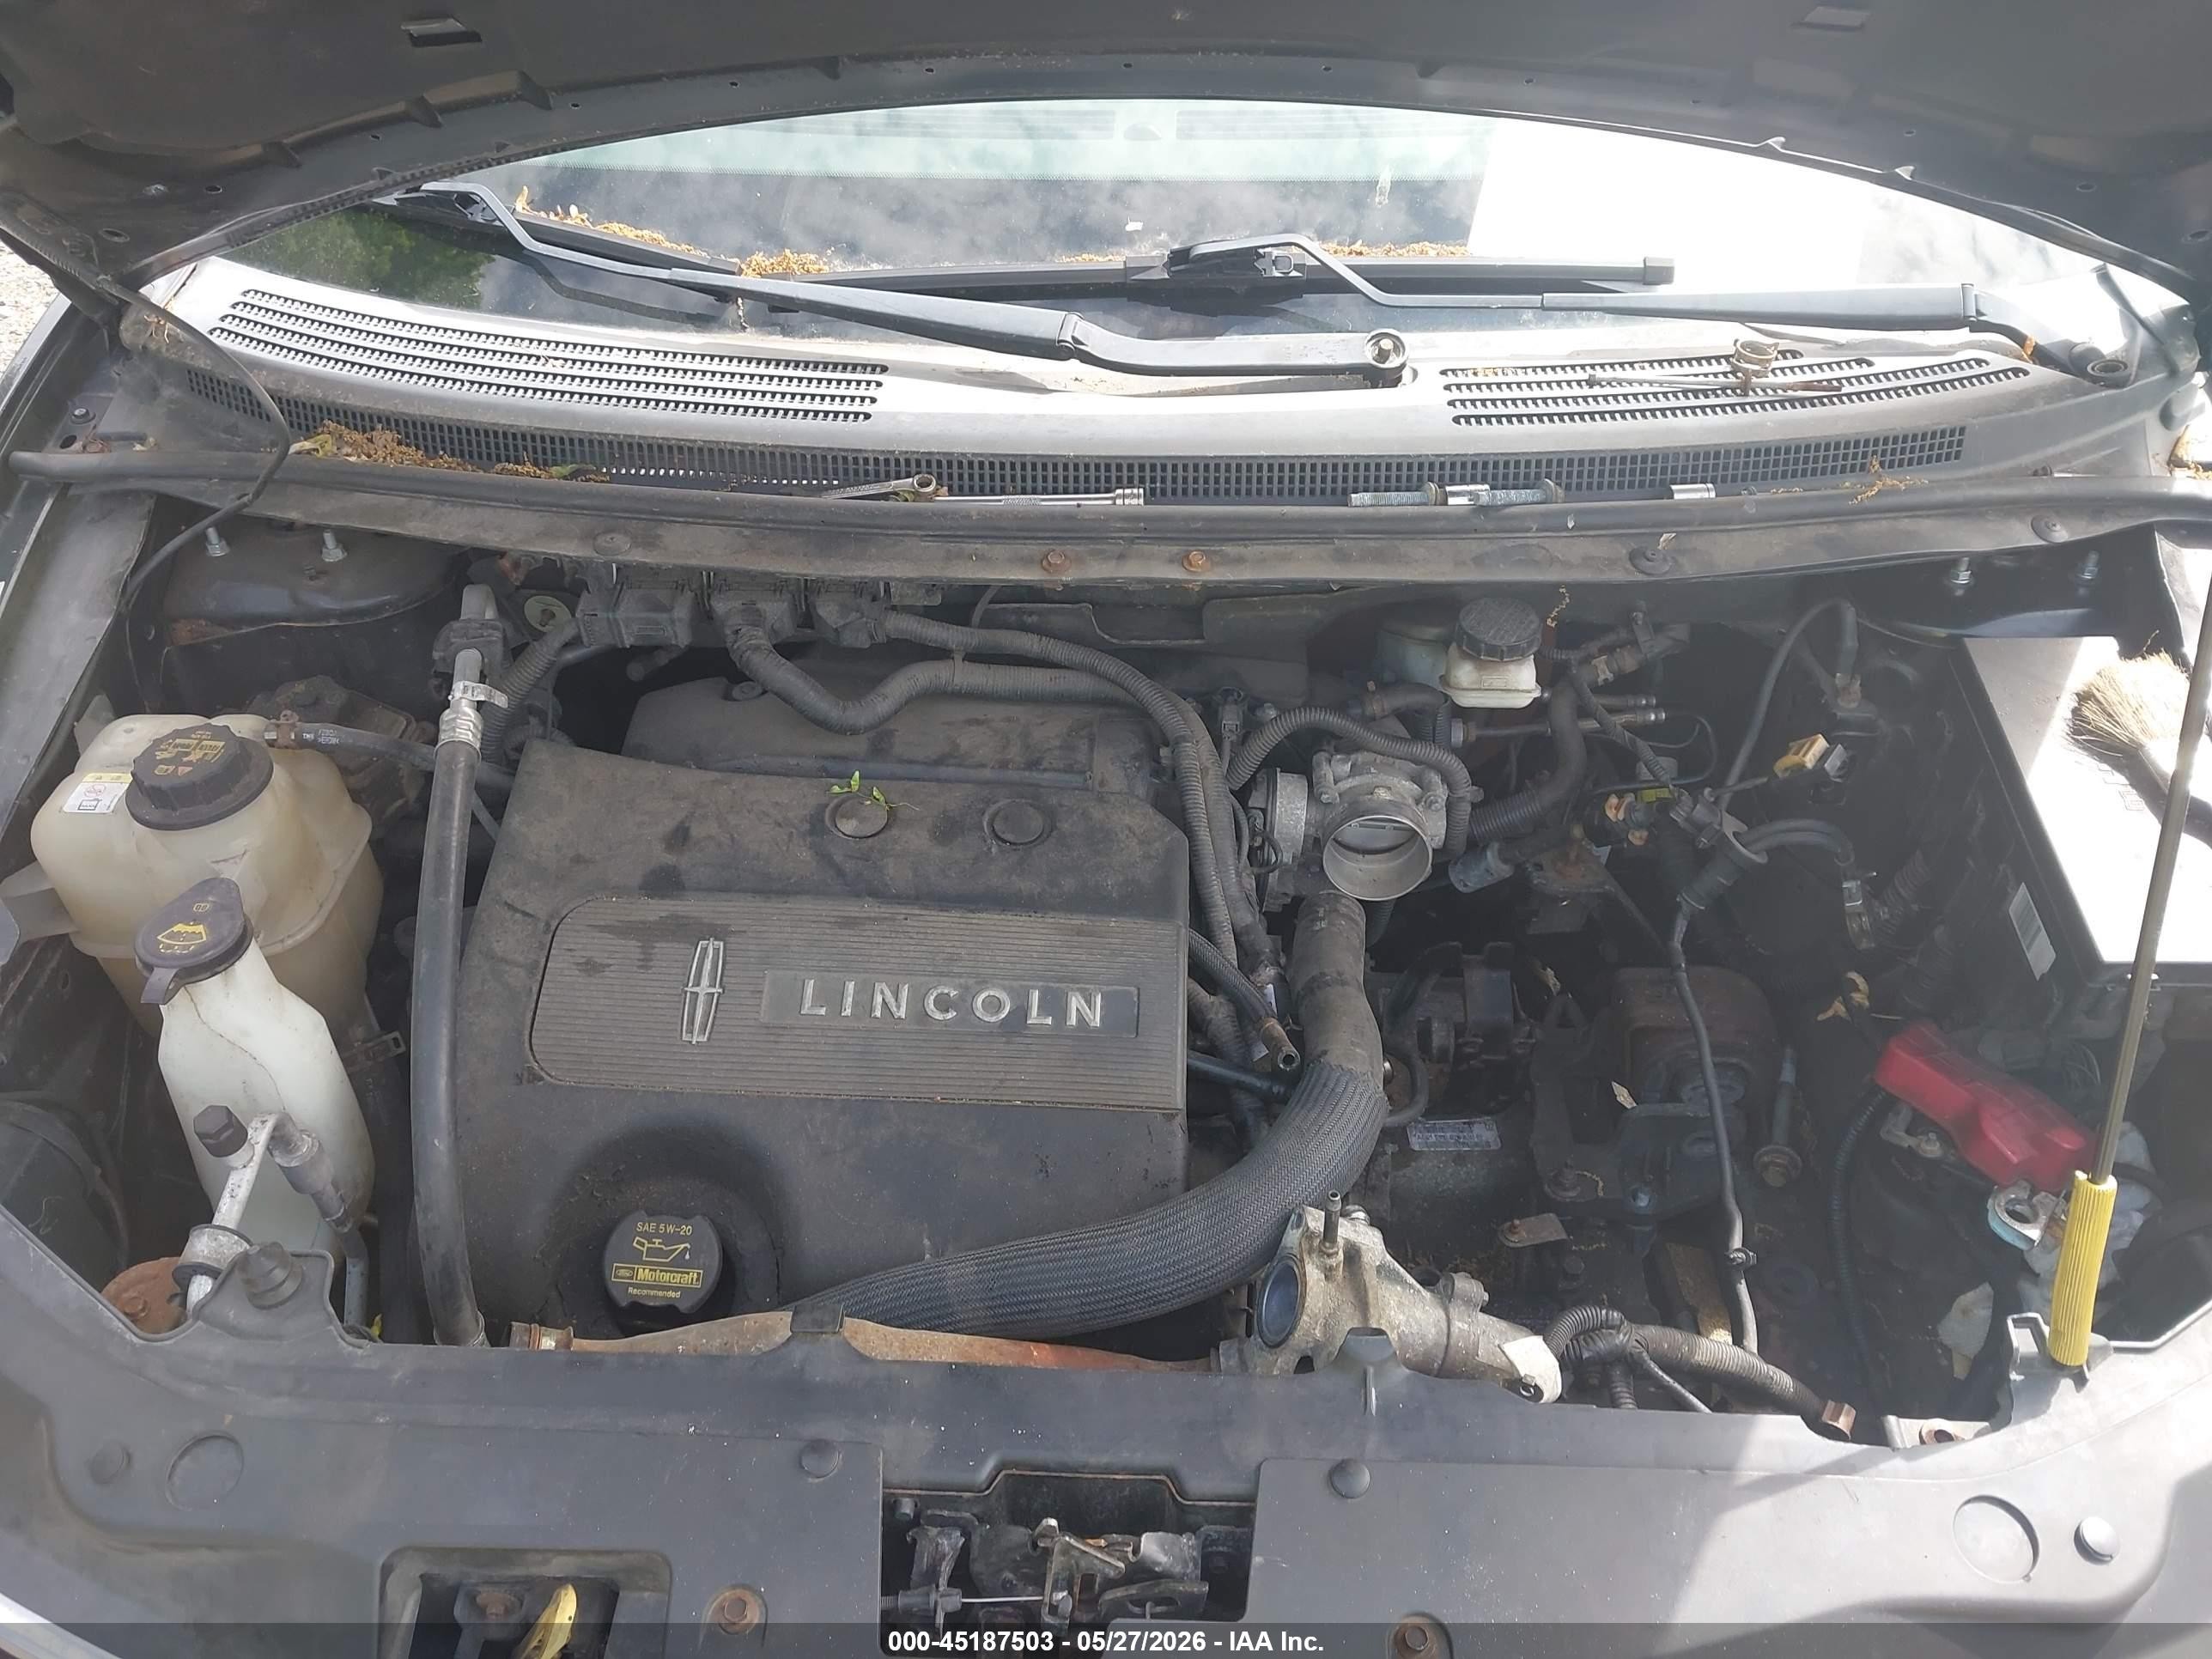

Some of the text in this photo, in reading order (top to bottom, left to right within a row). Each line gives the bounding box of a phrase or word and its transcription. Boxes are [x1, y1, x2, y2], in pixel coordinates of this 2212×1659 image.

[799, 978, 1102, 1029] LINCOLN
[636, 1222, 693, 1236] SAE 5W-20
[637, 1267, 699, 1285] Motorcraft
[628, 1286, 681, 1298] Recommended
